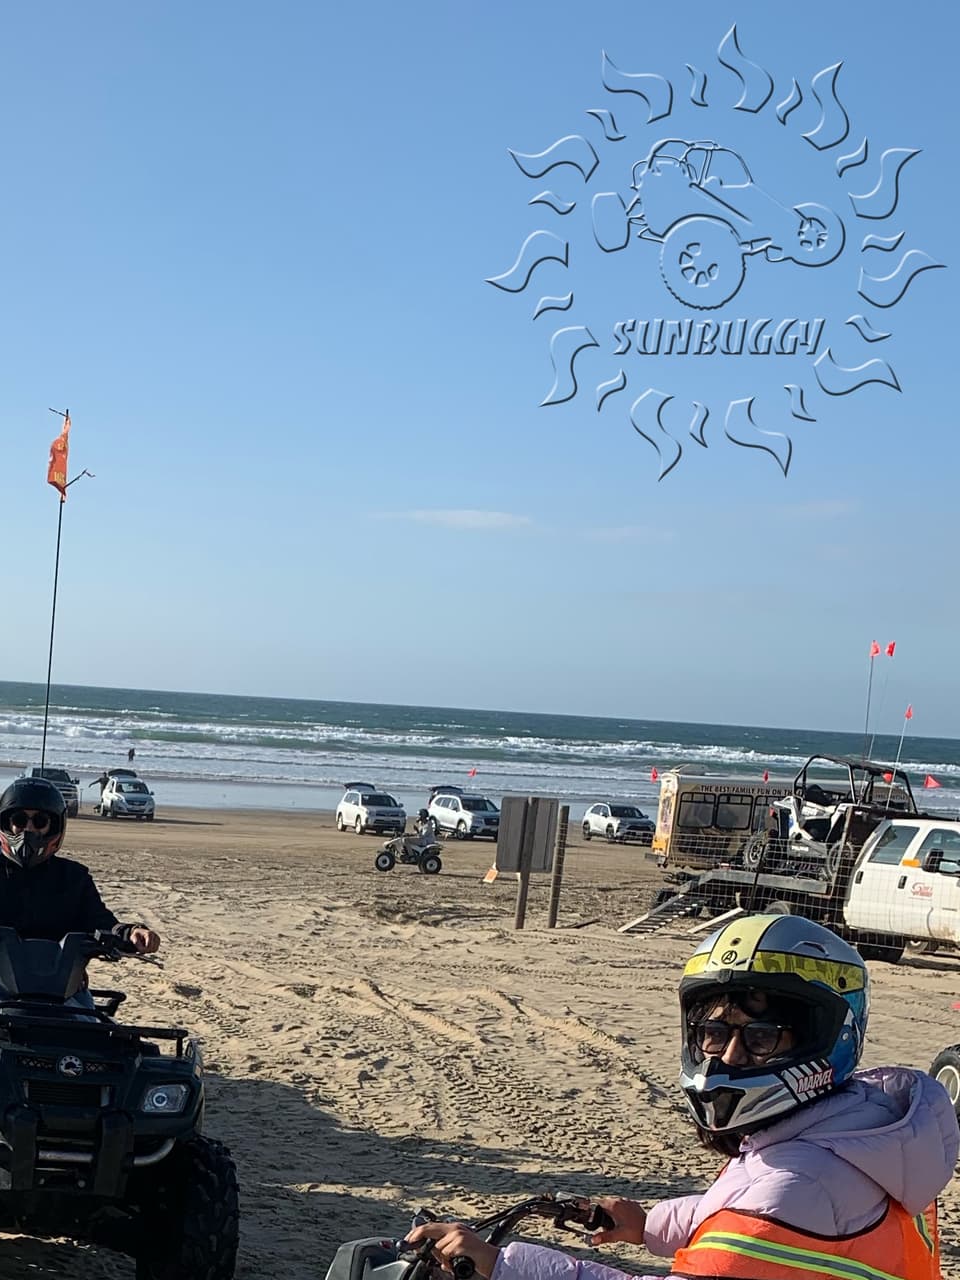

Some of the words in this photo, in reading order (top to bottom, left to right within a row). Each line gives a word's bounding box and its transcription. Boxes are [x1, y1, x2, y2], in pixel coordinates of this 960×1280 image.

[700, 785, 713, 793] THE
[714, 785, 730, 793] BEST
[732, 786, 755, 795] FAMILY
[756, 787, 770, 796] FUN
[771, 788, 782, 796] ON
[798, 1068, 833, 1093] MARVEL
